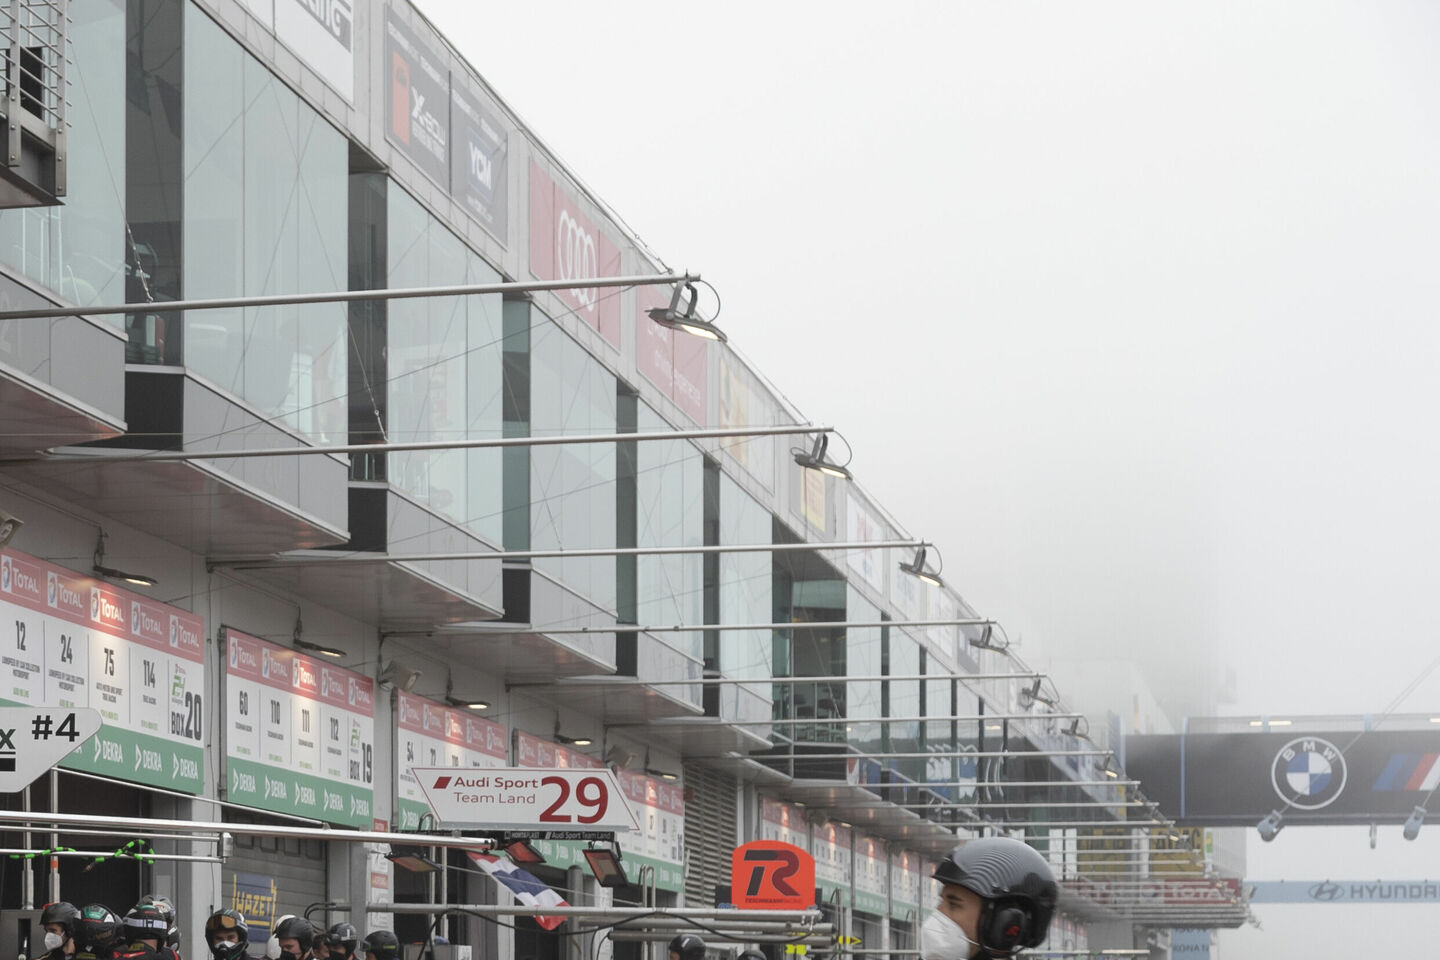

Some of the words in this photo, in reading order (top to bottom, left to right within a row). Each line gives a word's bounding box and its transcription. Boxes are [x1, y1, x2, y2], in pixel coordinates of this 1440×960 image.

[12, 568, 40, 594] TOTAL
[58, 583, 83, 609] TOTAL
[101, 598, 124, 623] TOTAL
[15, 620, 26, 651] 12
[179, 624, 200, 647] TOTAL
[60, 634, 73, 665] 24
[104, 647, 115, 676] 75
[143, 659, 156, 688] 114
[32, 713, 80, 742] #4
[185, 691, 202, 741] 20
[102, 740, 123, 763] DEKRA
[143, 750, 162, 772] DEKRA
[362, 742, 372, 784] 19
[1281, 741, 1336, 764] BMW
[180, 758, 198, 780] DEKRA
[454, 776, 490, 788] Audi
[495, 776, 538, 790] Sport
[454, 791, 495, 804] Team
[499, 792, 536, 804] Land
[539, 776, 609, 824] 29
[1350, 884, 1440, 899] HYUNDA
